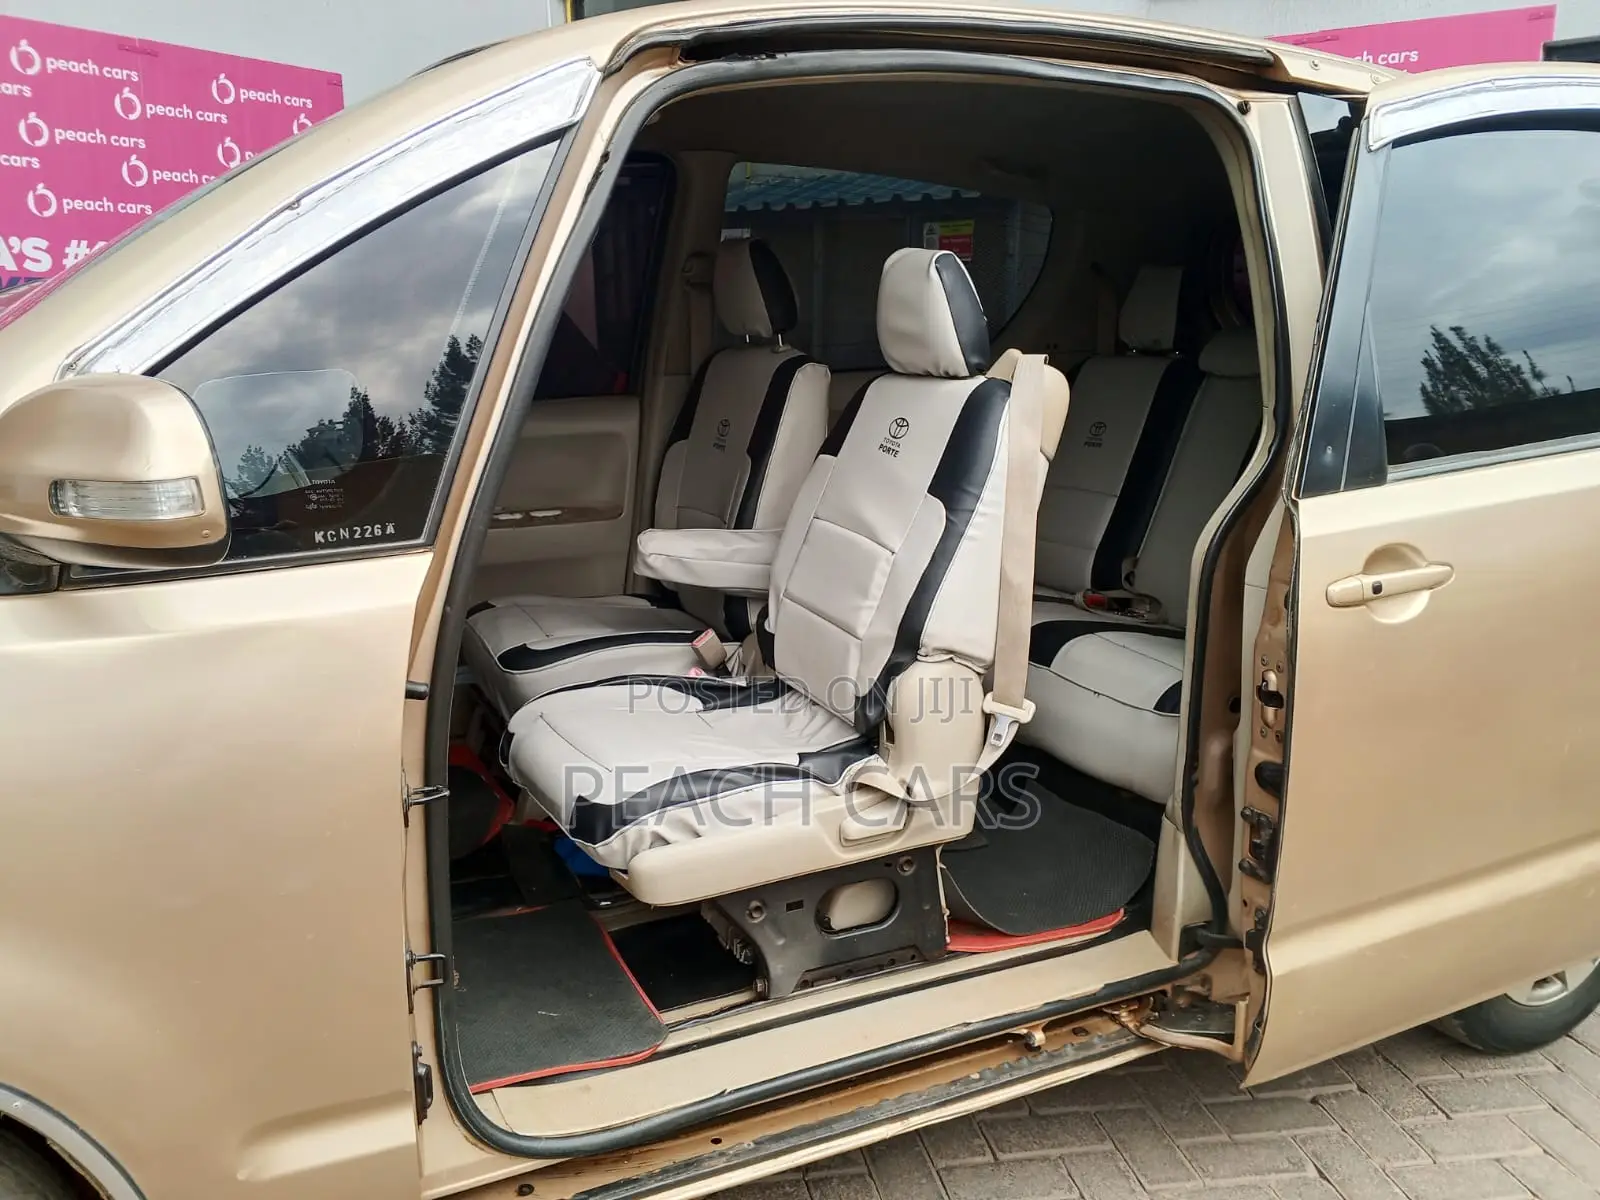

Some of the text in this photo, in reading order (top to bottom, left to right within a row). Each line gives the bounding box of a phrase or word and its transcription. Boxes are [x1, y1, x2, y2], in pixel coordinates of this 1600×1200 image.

[1378, 50, 1419, 65] cars
[46, 57, 139, 82] peach cars
[0, 82, 32, 97] ars
[240, 88, 313, 109] peach cars
[146, 103, 228, 124] peach cars
[54, 127, 146, 149] peach cars
[0, 153, 41, 169] cars
[152, 168, 199, 185] peach
[62, 197, 153, 215] peach cars
[878, 443, 900, 458] PORTE
